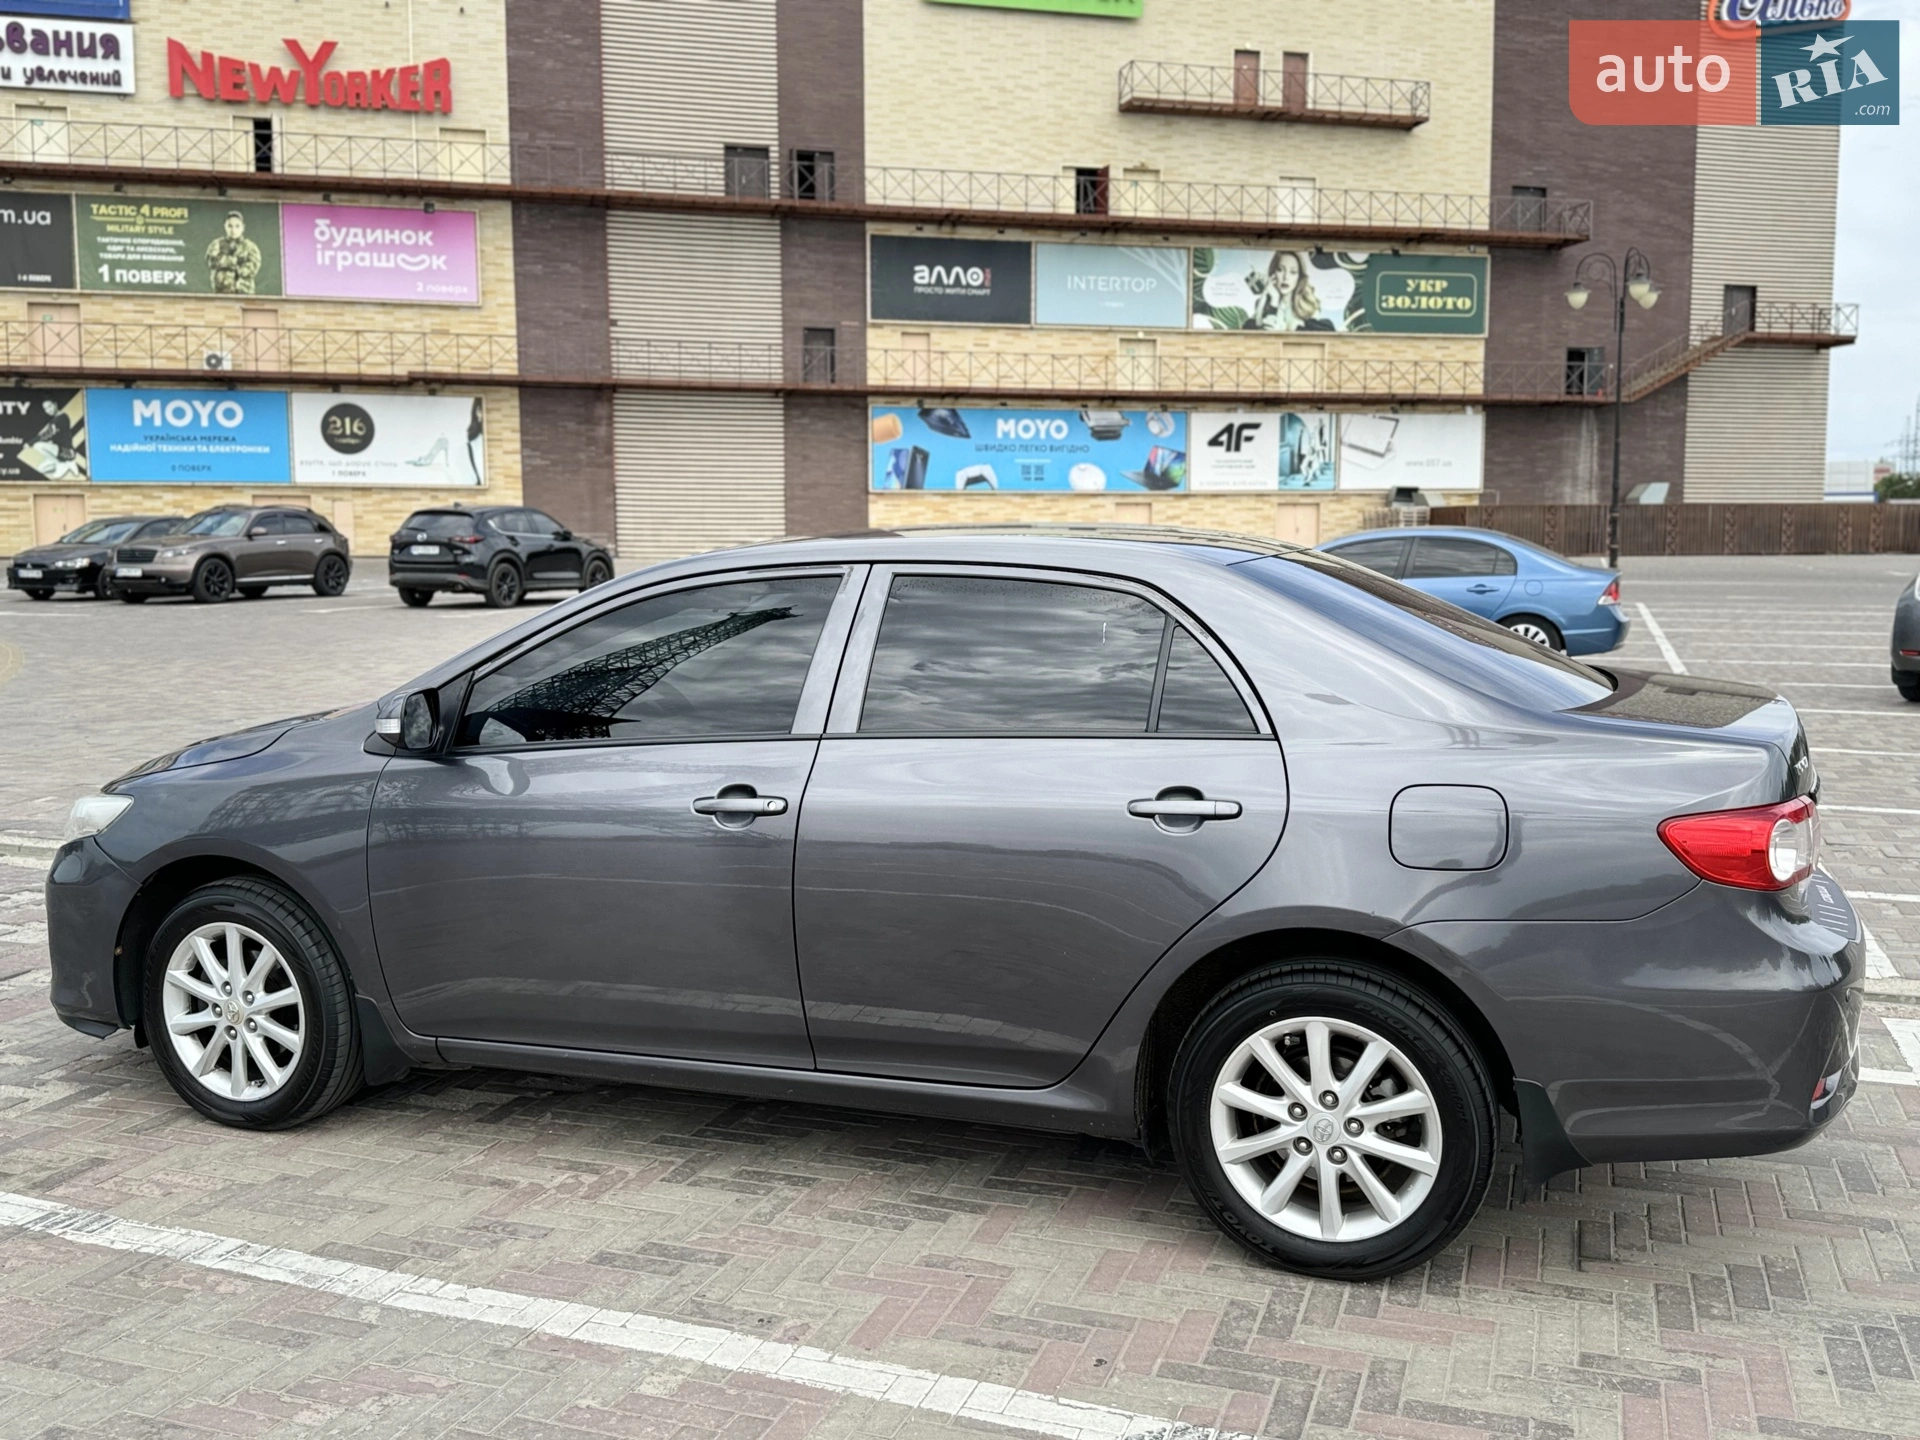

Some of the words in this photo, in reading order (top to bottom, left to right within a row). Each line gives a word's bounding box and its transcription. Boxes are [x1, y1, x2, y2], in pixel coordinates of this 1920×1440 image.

[0, 21, 121, 61] вания
[23, 65, 122, 87] увлечений
[90, 203, 138, 217] TACTIC
[140, 203, 151, 217] 4
[152, 206, 189, 219] PROFI
[106, 223, 146, 234] MILITARY
[147, 225, 175, 236] STYLE
[314, 218, 434, 248] будинок
[98, 263, 110, 283] 1
[115, 268, 187, 285] ПОВЕРХ
[1066, 273, 1158, 293] INTERTOP
[1405, 278, 1449, 293] УКР
[1381, 294, 1472, 311] ЗОЛОТО
[132, 398, 245, 429] MOYO
[326, 414, 367, 437] 216
[996, 418, 1069, 440] MOYO
[975, 442, 1017, 453] ШВИДКО
[1018, 443, 1048, 454] ЛЕГКО
[1206, 422, 1263, 453] 4F
[1221, 1210, 1279, 1255] TOYO
